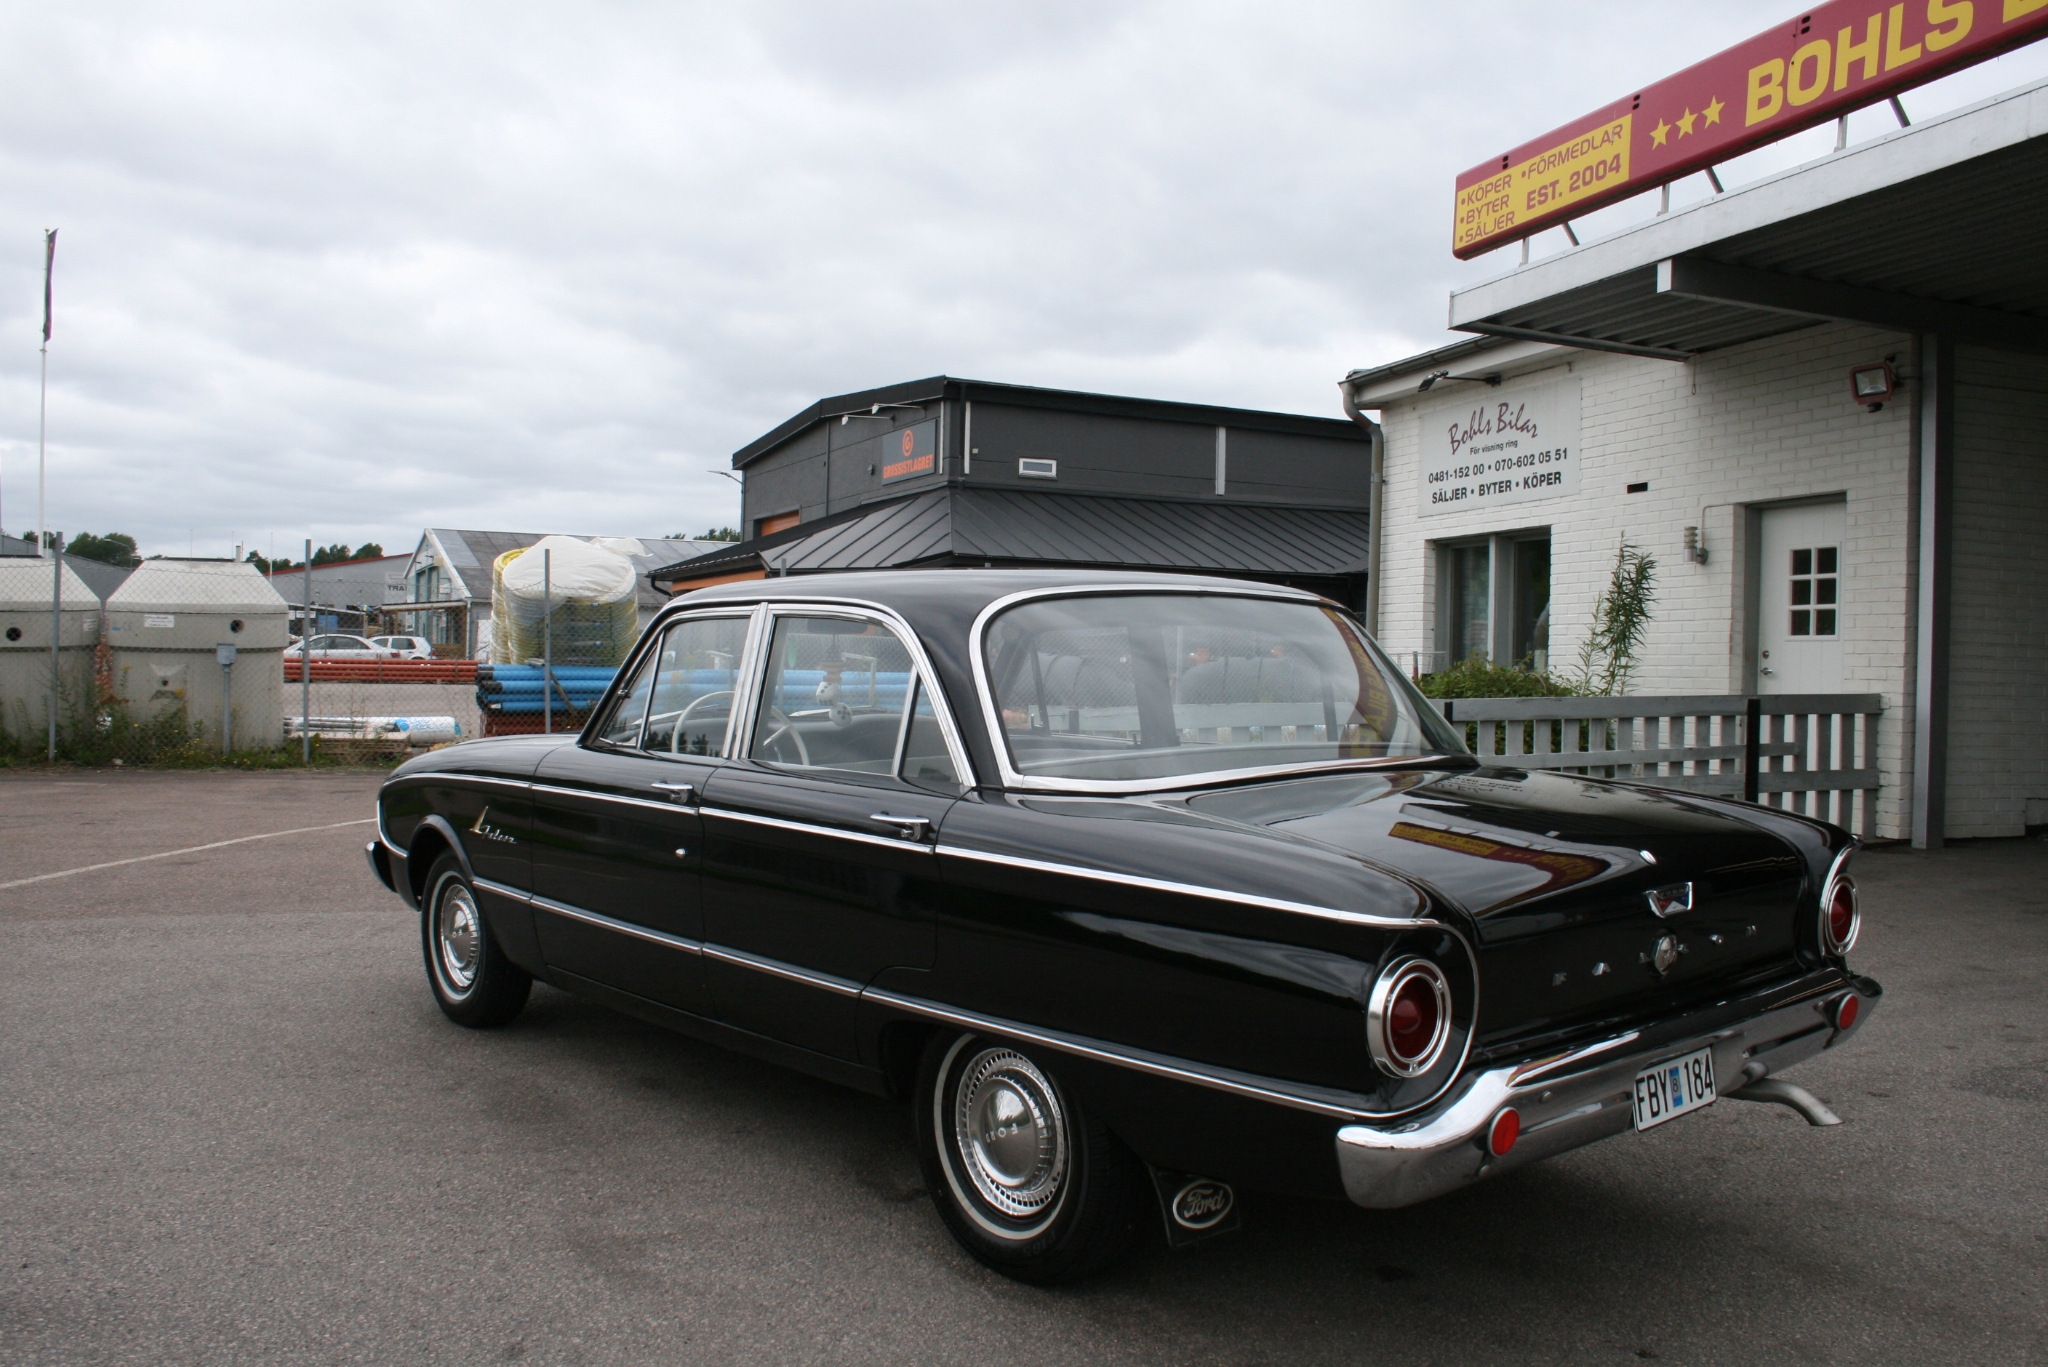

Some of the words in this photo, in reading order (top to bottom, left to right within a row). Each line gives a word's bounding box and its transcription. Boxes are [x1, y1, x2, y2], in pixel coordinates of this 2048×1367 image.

[1745, 0, 1974, 127] BOHLS
[1527, 123, 1623, 179] FÖRMEDLAR
[1467, 173, 1512, 206] KÖPER
[1526, 179, 1563, 211] EST.
[1568, 153, 1622, 193] 2004
[1465, 194, 1510, 225] BYTER
[1465, 210, 1515, 244] SÄLJER
[1448, 406, 1492, 455] Bohls
[1496, 402, 1539, 439] Bilar
[1470, 446, 1481, 455] För
[1482, 442, 1504, 453] visning
[1505, 439, 1518, 449] ring
[1428, 466, 1470, 484] 0481-152
[1472, 463, 1485, 476] 00
[1494, 453, 1535, 472] 070-602
[1538, 450, 1551, 464] 05
[1554, 447, 1568, 461] 51
[1432, 486, 1467, 504] SÄLJER
[1478, 479, 1512, 497] BYTER
[1523, 471, 1562, 489] KÖPER
[1635, 1069, 1668, 1122] FBY
[1684, 1053, 1714, 1103] 184
[1183, 1188, 1225, 1219] Ford
